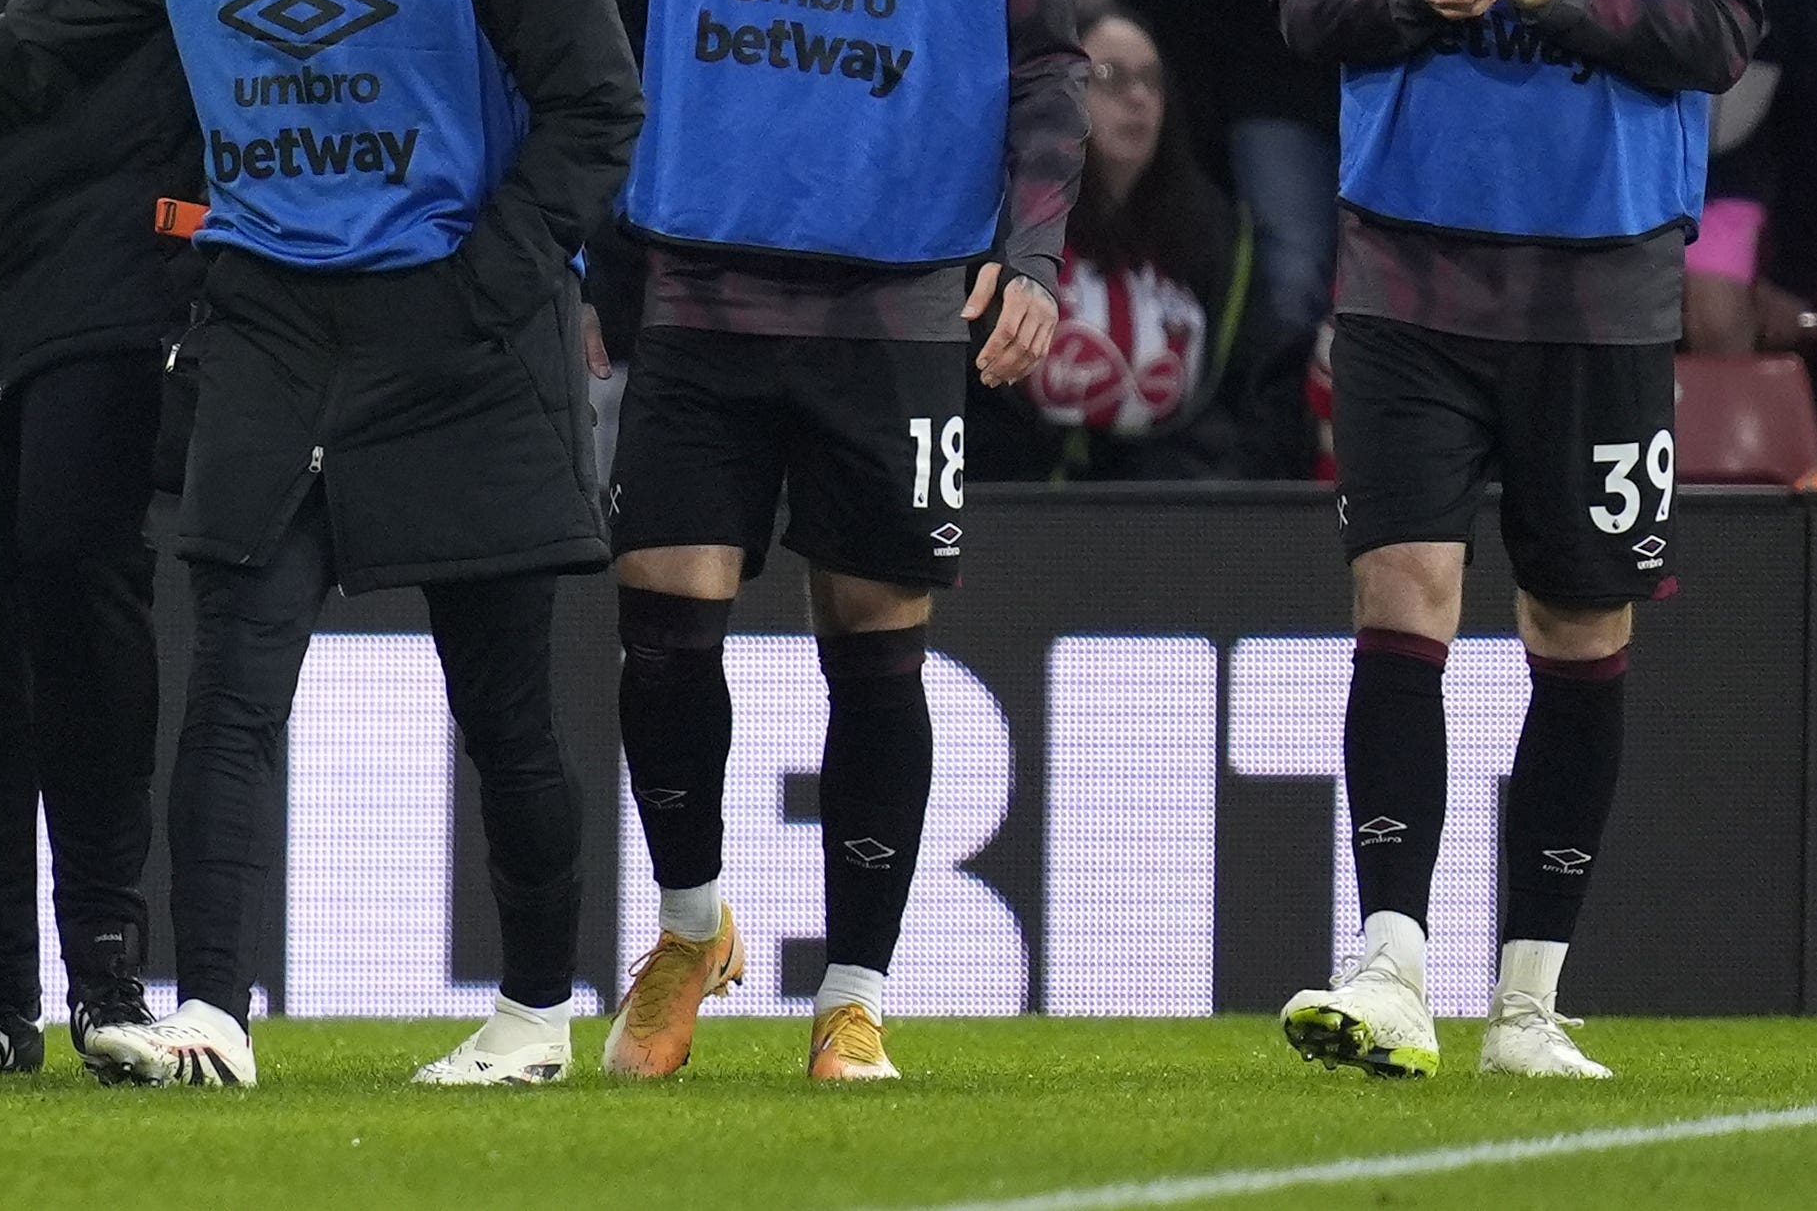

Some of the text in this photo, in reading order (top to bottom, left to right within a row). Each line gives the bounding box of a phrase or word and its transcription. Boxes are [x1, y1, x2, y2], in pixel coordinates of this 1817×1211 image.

[235, 65, 381, 108] umbro
[695, 7, 915, 99] betway
[210, 127, 420, 185] betway
[909, 415, 965, 510] 18
[1589, 428, 1675, 535] 39
